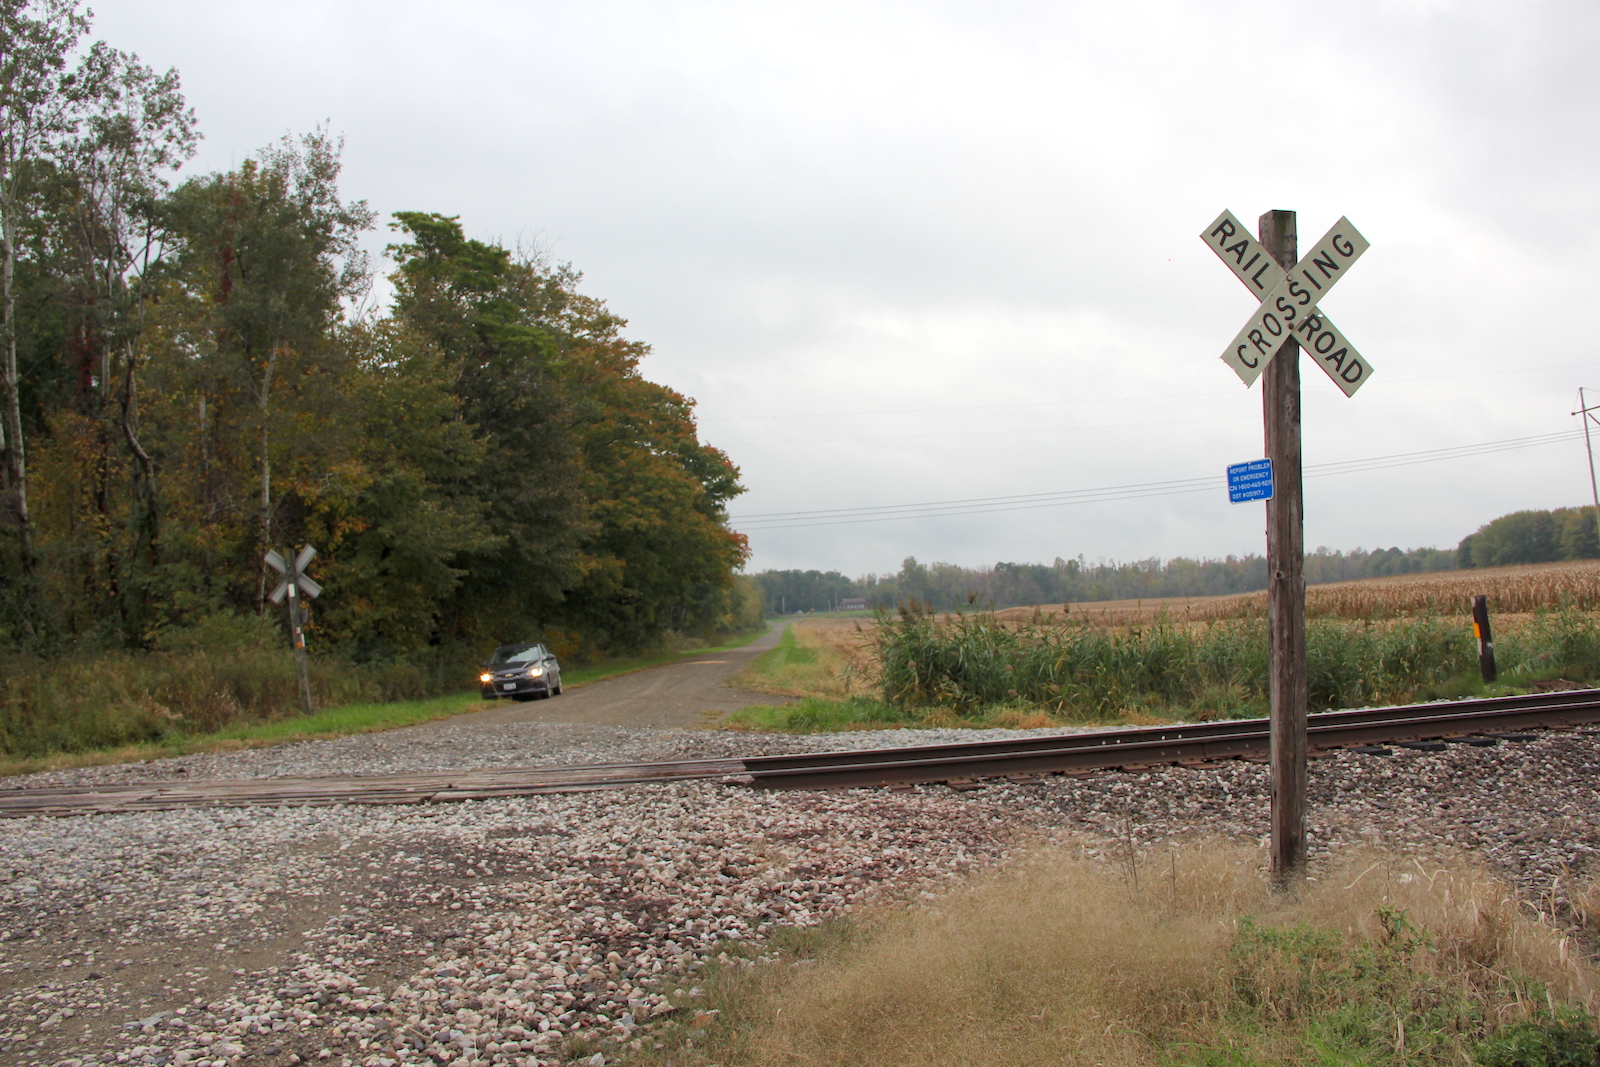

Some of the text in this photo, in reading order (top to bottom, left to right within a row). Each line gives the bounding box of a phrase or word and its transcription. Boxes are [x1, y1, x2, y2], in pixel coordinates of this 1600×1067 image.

[1210, 218, 1363, 384] RAIL ROAD
[1237, 234, 1354, 369] CROSSING
[1230, 463, 1270, 474] REPORT PROBLEM
[1240, 471, 1269, 481] EMERGENCY
